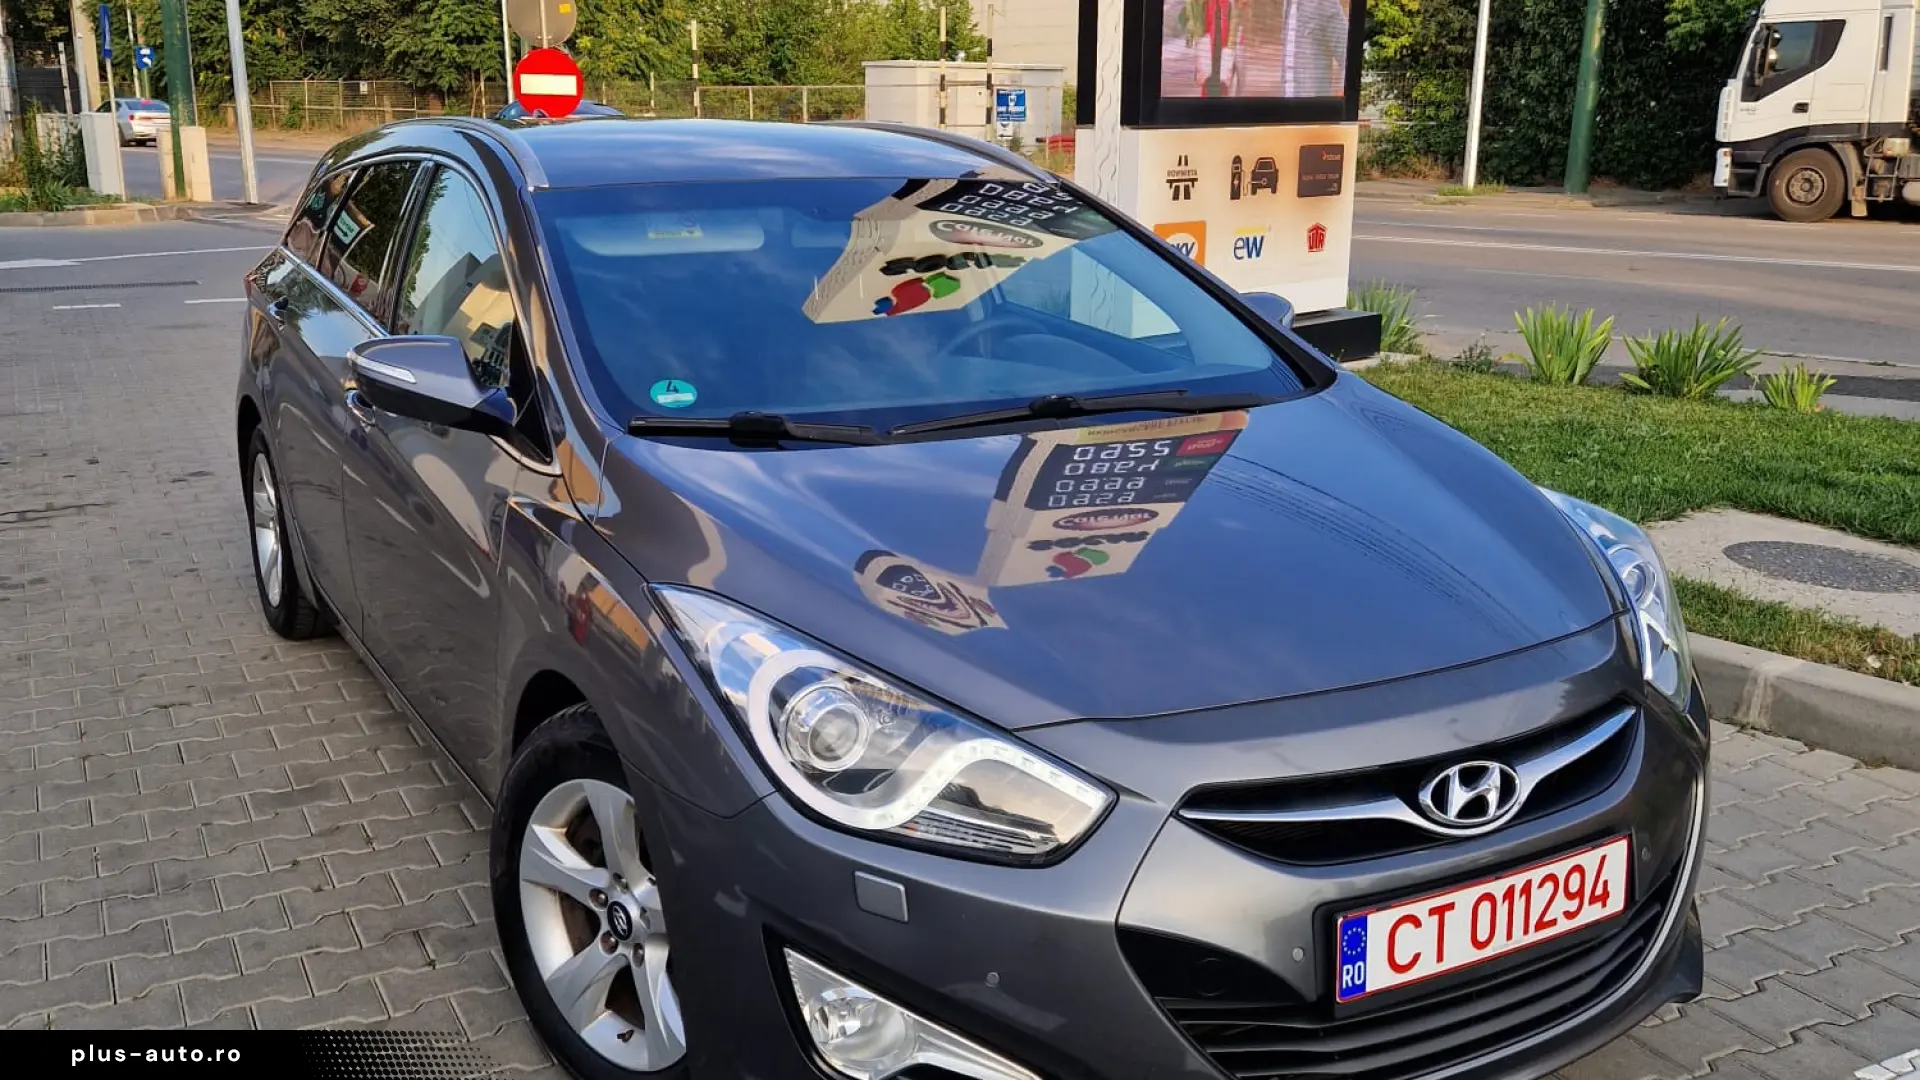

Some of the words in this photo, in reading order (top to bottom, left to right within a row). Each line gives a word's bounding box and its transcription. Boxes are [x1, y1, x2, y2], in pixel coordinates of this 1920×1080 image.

[666, 380, 678, 393] 4
[1387, 902, 1455, 974] CT
[1470, 854, 1611, 950] 011294
[1342, 961, 1365, 989] RO
